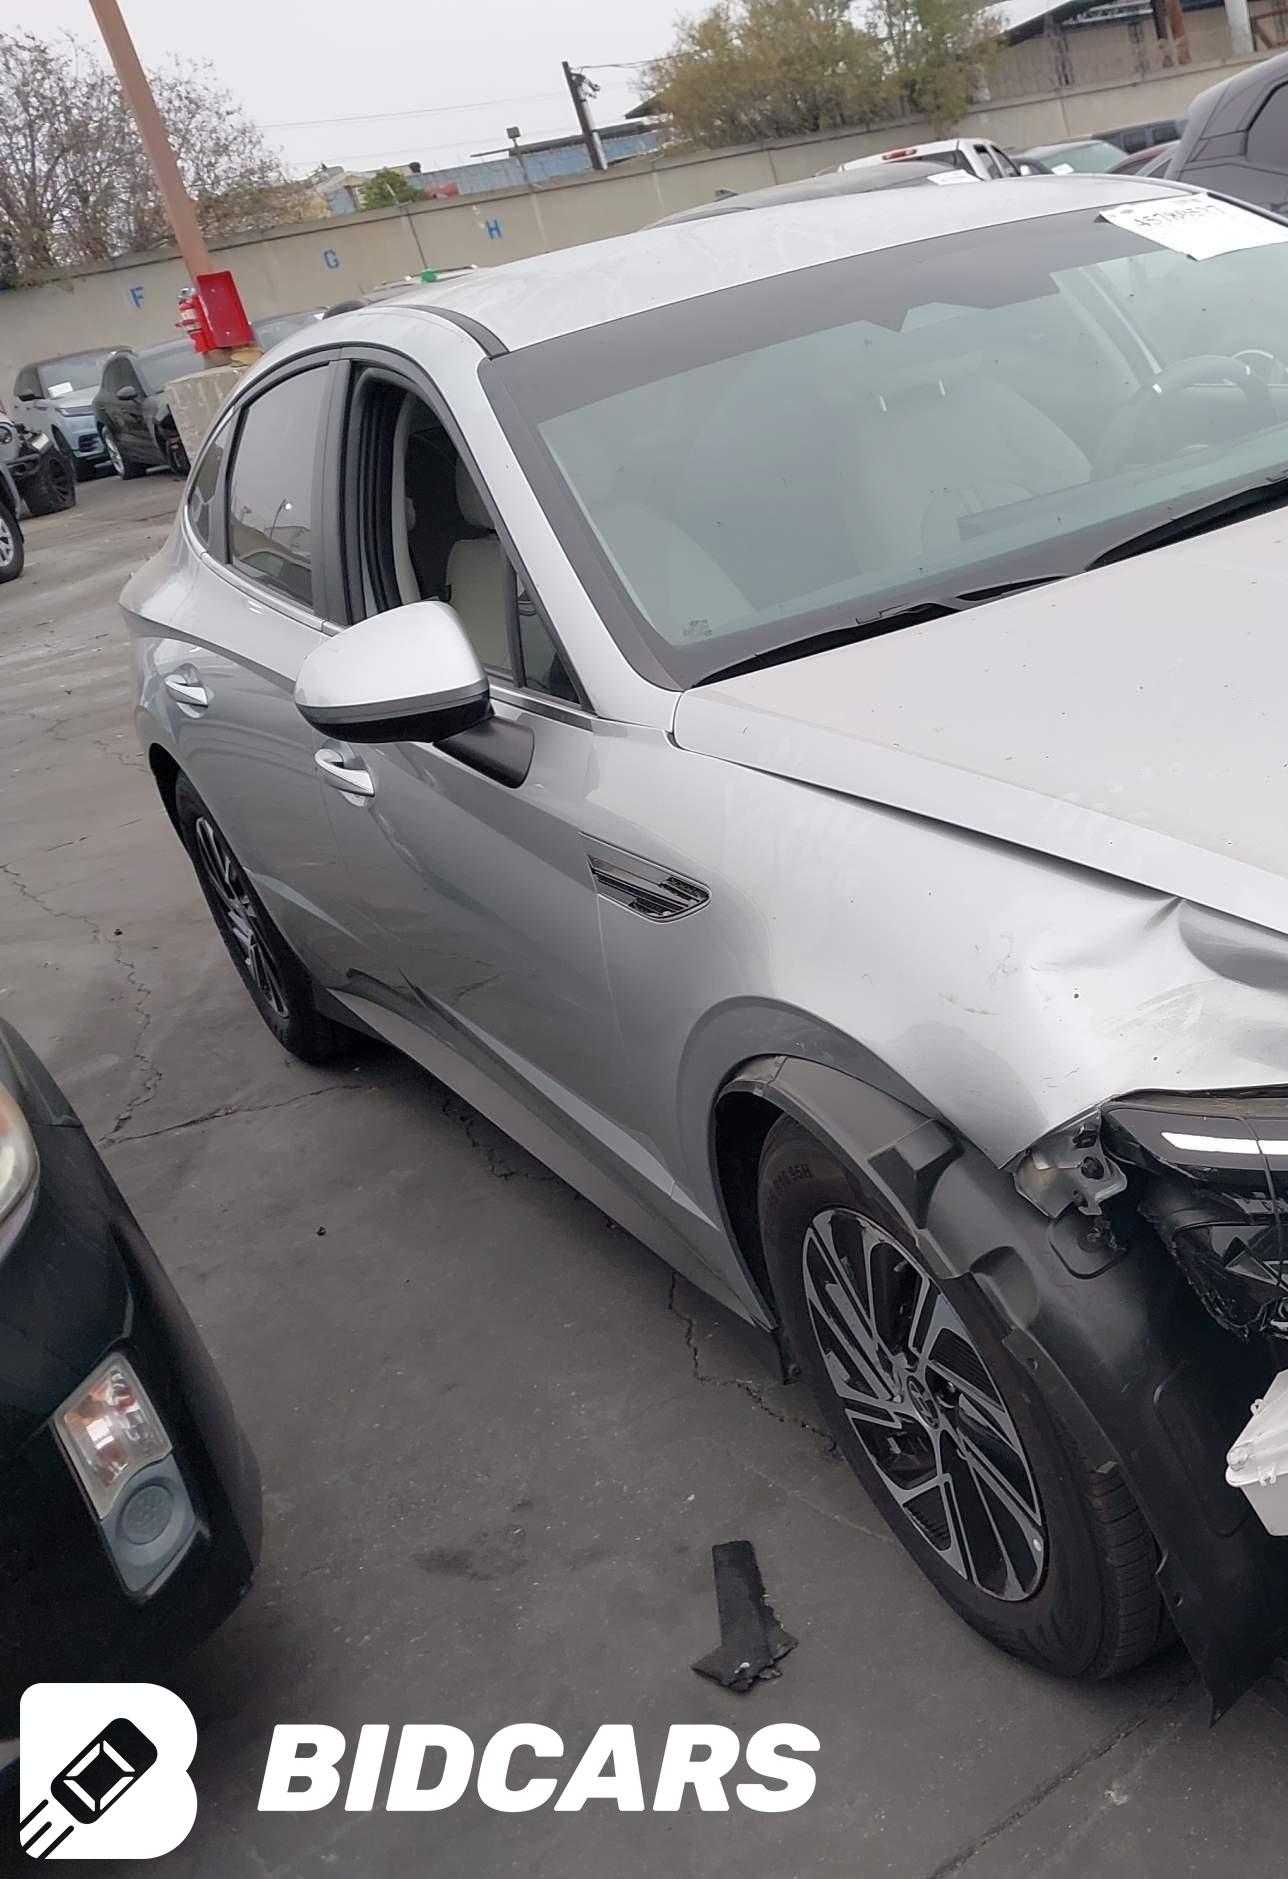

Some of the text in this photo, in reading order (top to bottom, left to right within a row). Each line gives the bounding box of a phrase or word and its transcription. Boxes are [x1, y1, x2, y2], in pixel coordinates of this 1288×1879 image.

[485, 219, 502, 240] H
[323, 249, 340, 270] G
[130, 286, 144, 309] F
